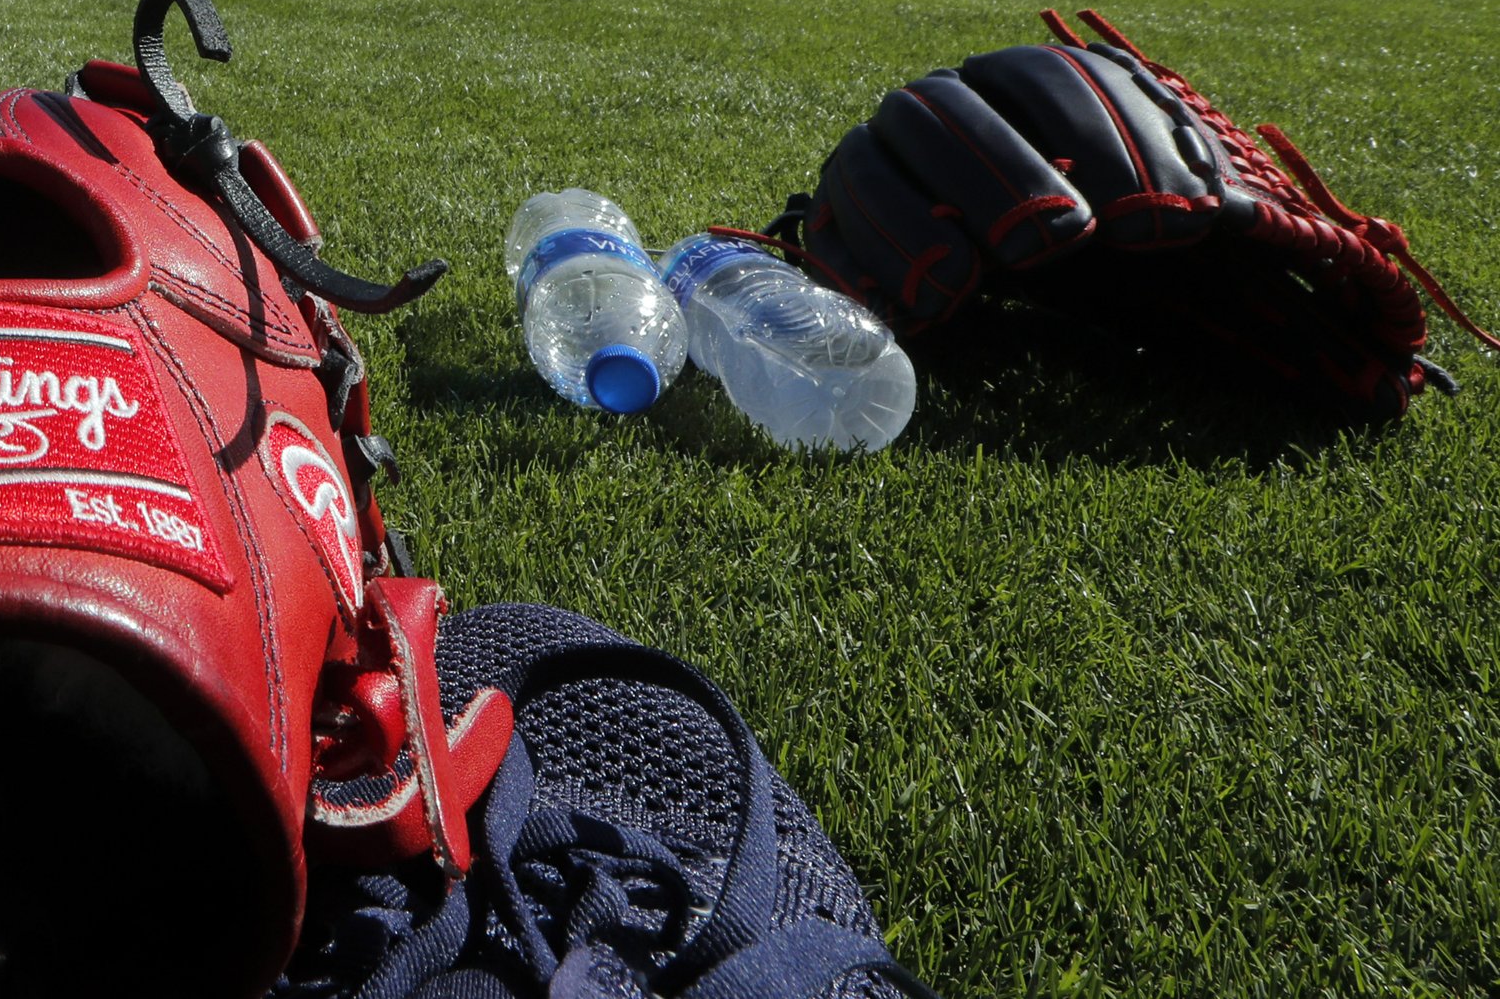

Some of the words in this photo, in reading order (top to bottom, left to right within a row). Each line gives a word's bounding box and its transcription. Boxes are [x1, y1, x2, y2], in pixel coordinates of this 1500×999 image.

[667, 237, 761, 293] QUAFINA
[64, 488, 140, 533] Est.
[136, 502, 204, 553] 1887
